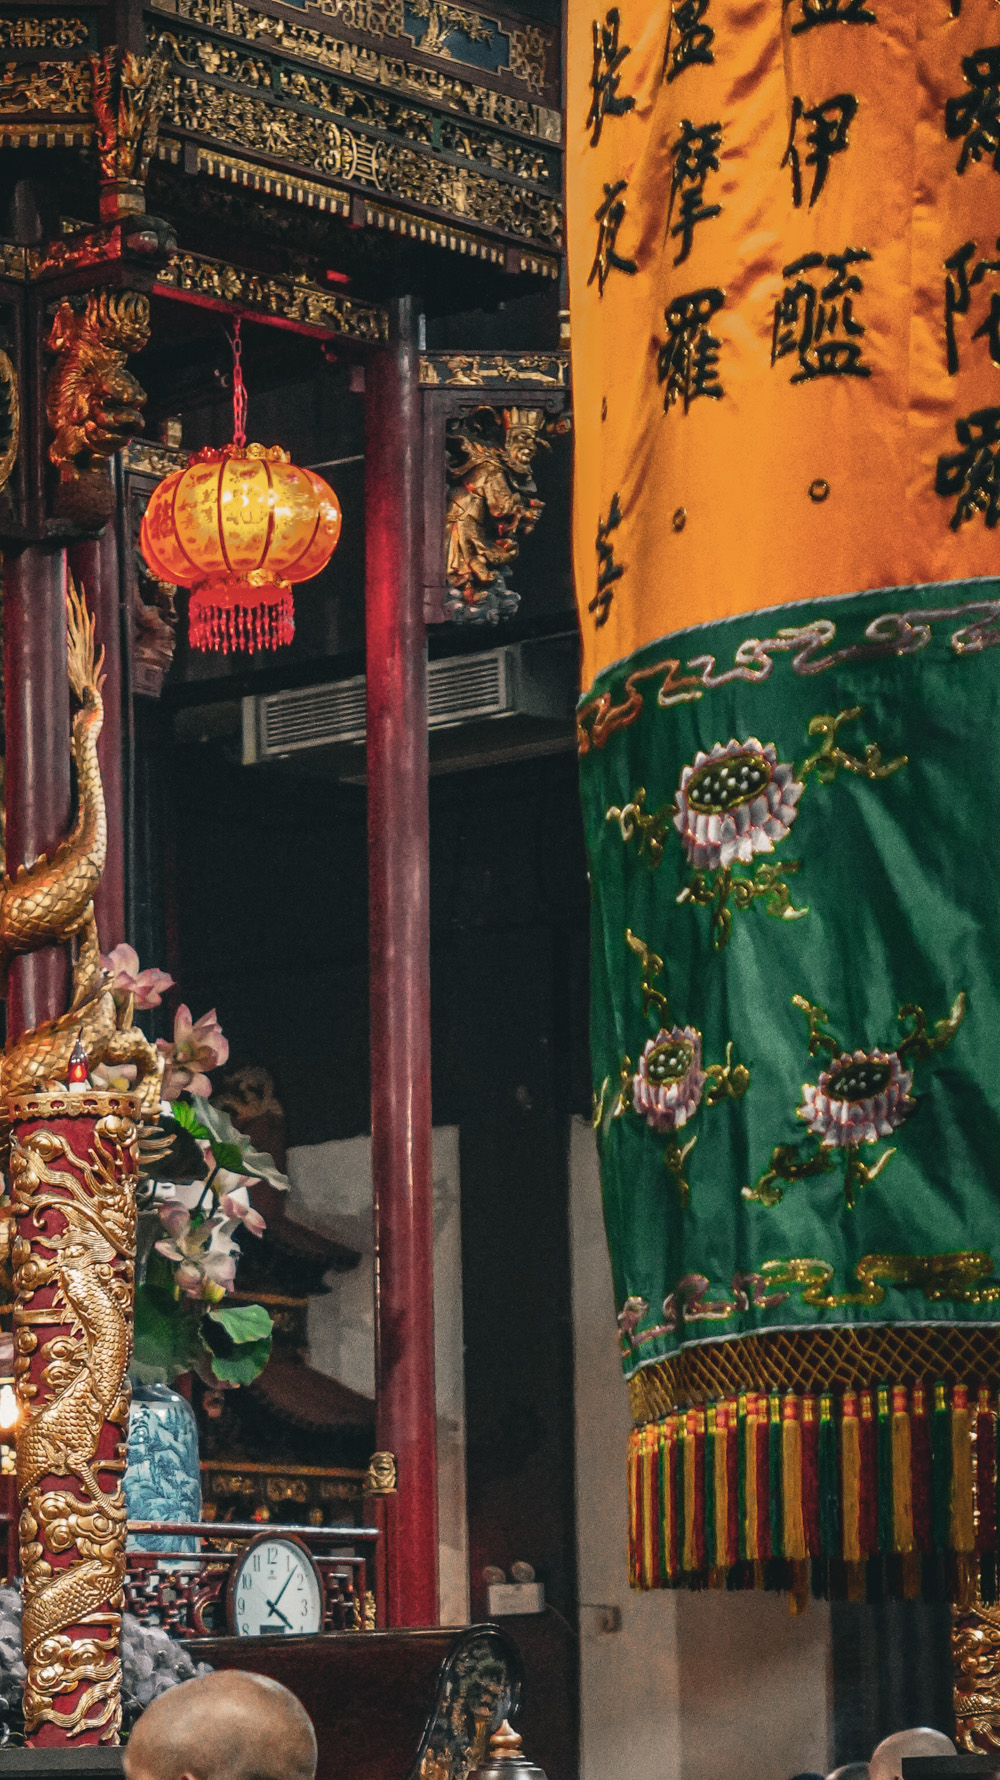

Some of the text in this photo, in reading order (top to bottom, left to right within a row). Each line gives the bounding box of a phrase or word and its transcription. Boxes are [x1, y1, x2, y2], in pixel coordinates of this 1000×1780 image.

[252, 1554, 261, 1572] 11
[266, 1547, 278, 1565] 12
[241, 1572, 252, 1591] 10
[296, 1574, 304, 1591] 2
[237, 1597, 246, 1616] 9
[300, 1599, 309, 1616] 3
